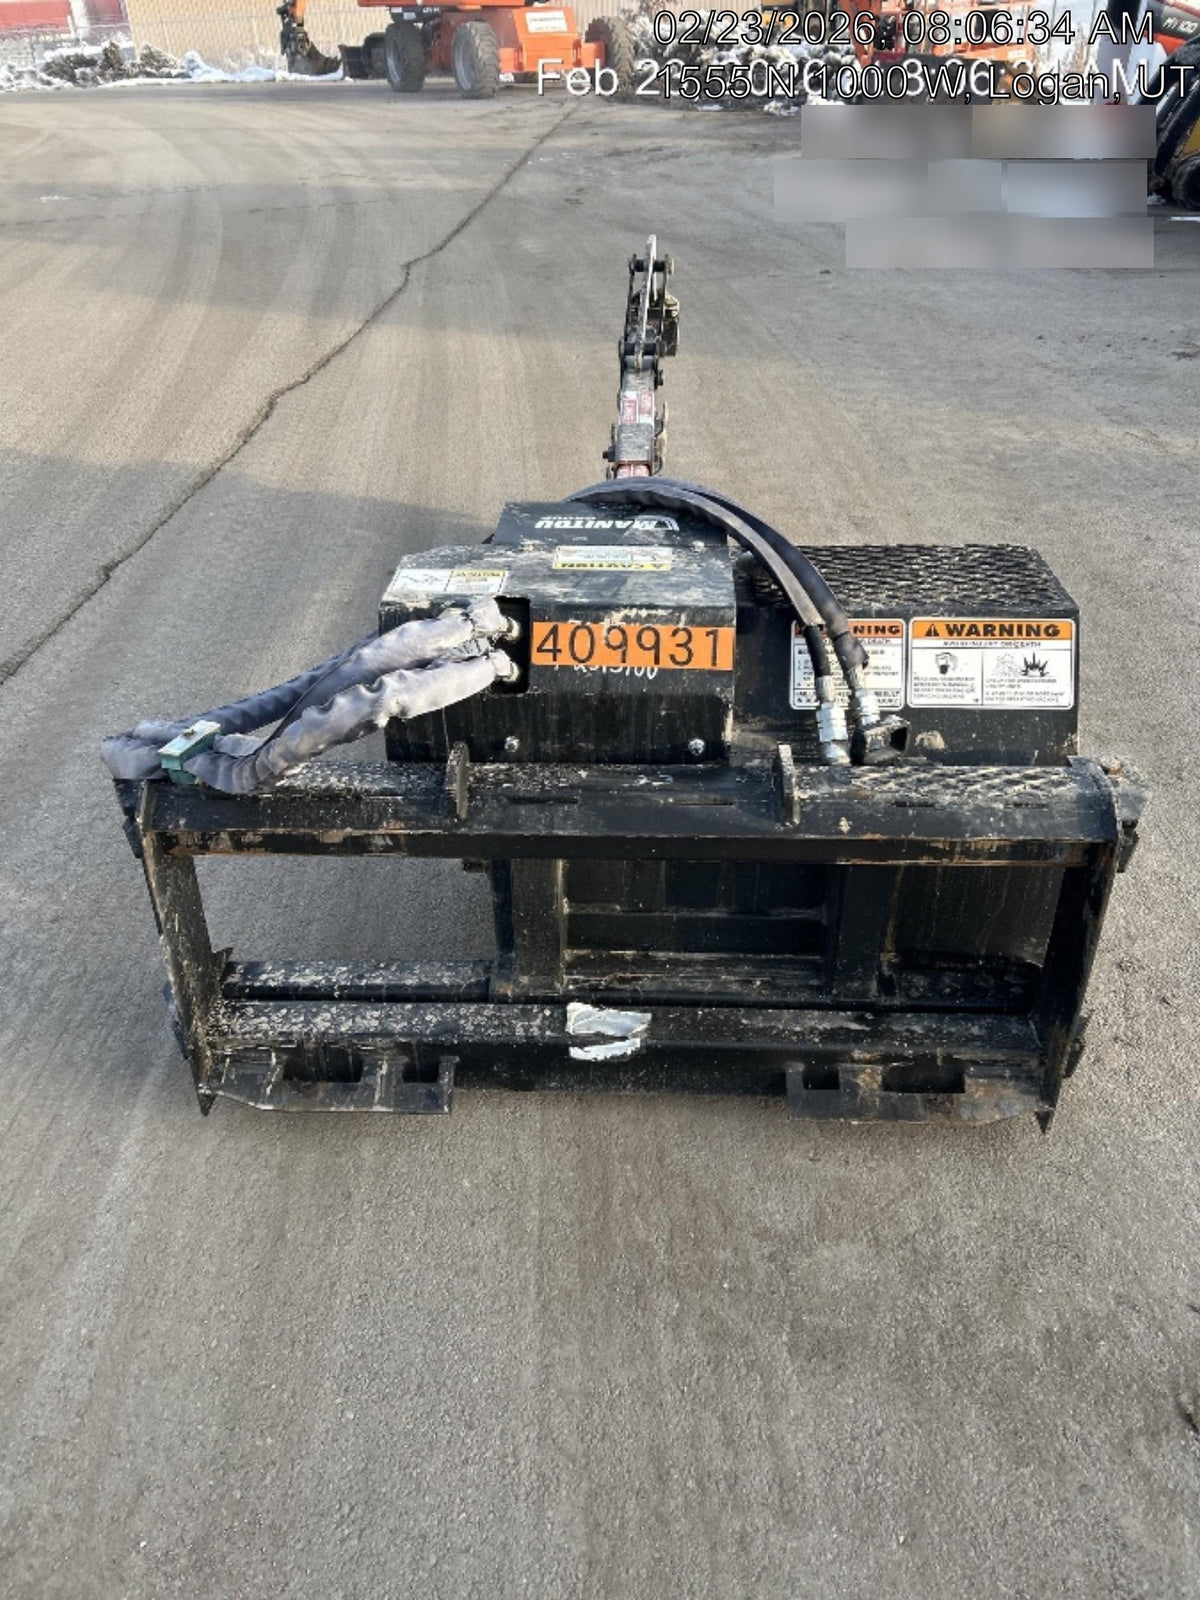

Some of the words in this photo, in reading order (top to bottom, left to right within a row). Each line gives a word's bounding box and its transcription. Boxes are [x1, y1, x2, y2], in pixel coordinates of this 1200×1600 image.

[534, 519, 658, 530] MANITOU
[945, 623, 1061, 637] WARNING
[536, 623, 720, 667] 409931
